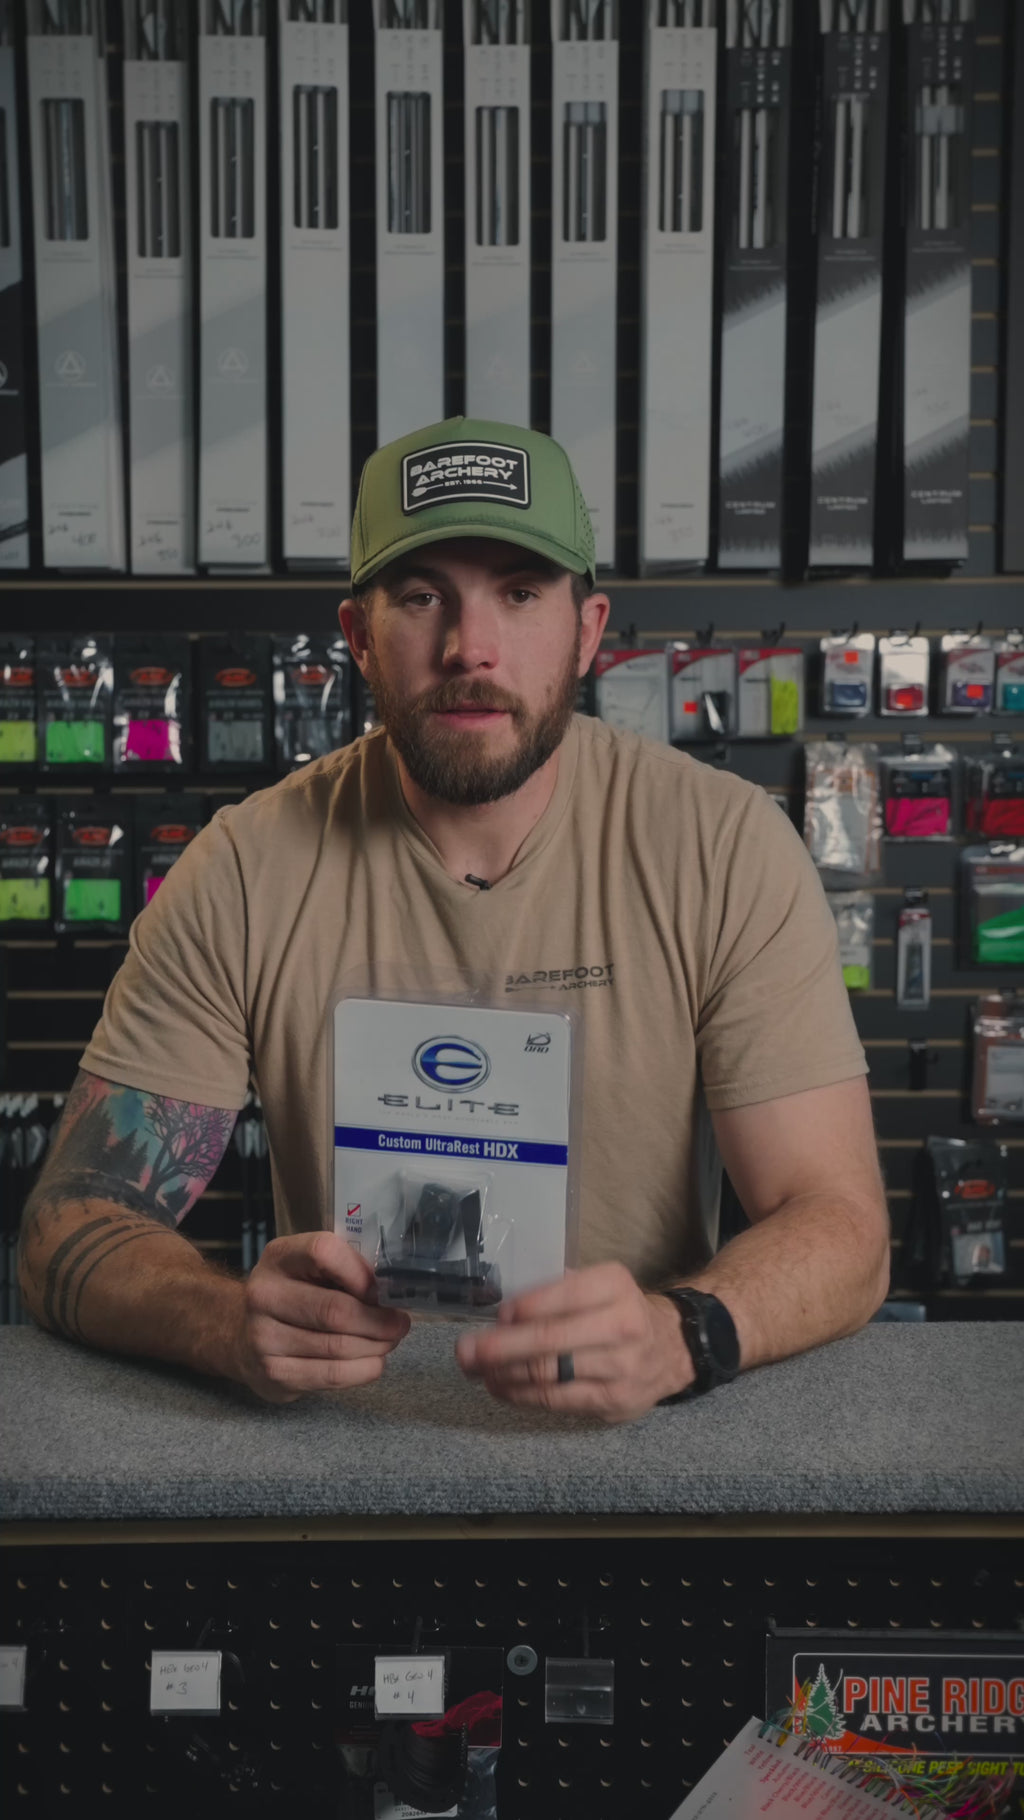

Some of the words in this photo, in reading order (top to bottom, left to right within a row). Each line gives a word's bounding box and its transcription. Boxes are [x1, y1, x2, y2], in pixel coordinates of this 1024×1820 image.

[410, 454, 518, 477] BAREFOOT
[415, 466, 512, 487] ARCHERY
[558, 979, 615, 990] ARCHERY
[377, 1094, 519, 1116] ELITE
[378, 1133, 421, 1150] Custom
[425, 1137, 480, 1155] UltraRest
[483, 1141, 519, 1159] HDX
[345, 1217, 363, 1225] RIGHT
[843, 1676, 930, 1714] PINE
[967, 1762, 1008, 1776] SIGHT
